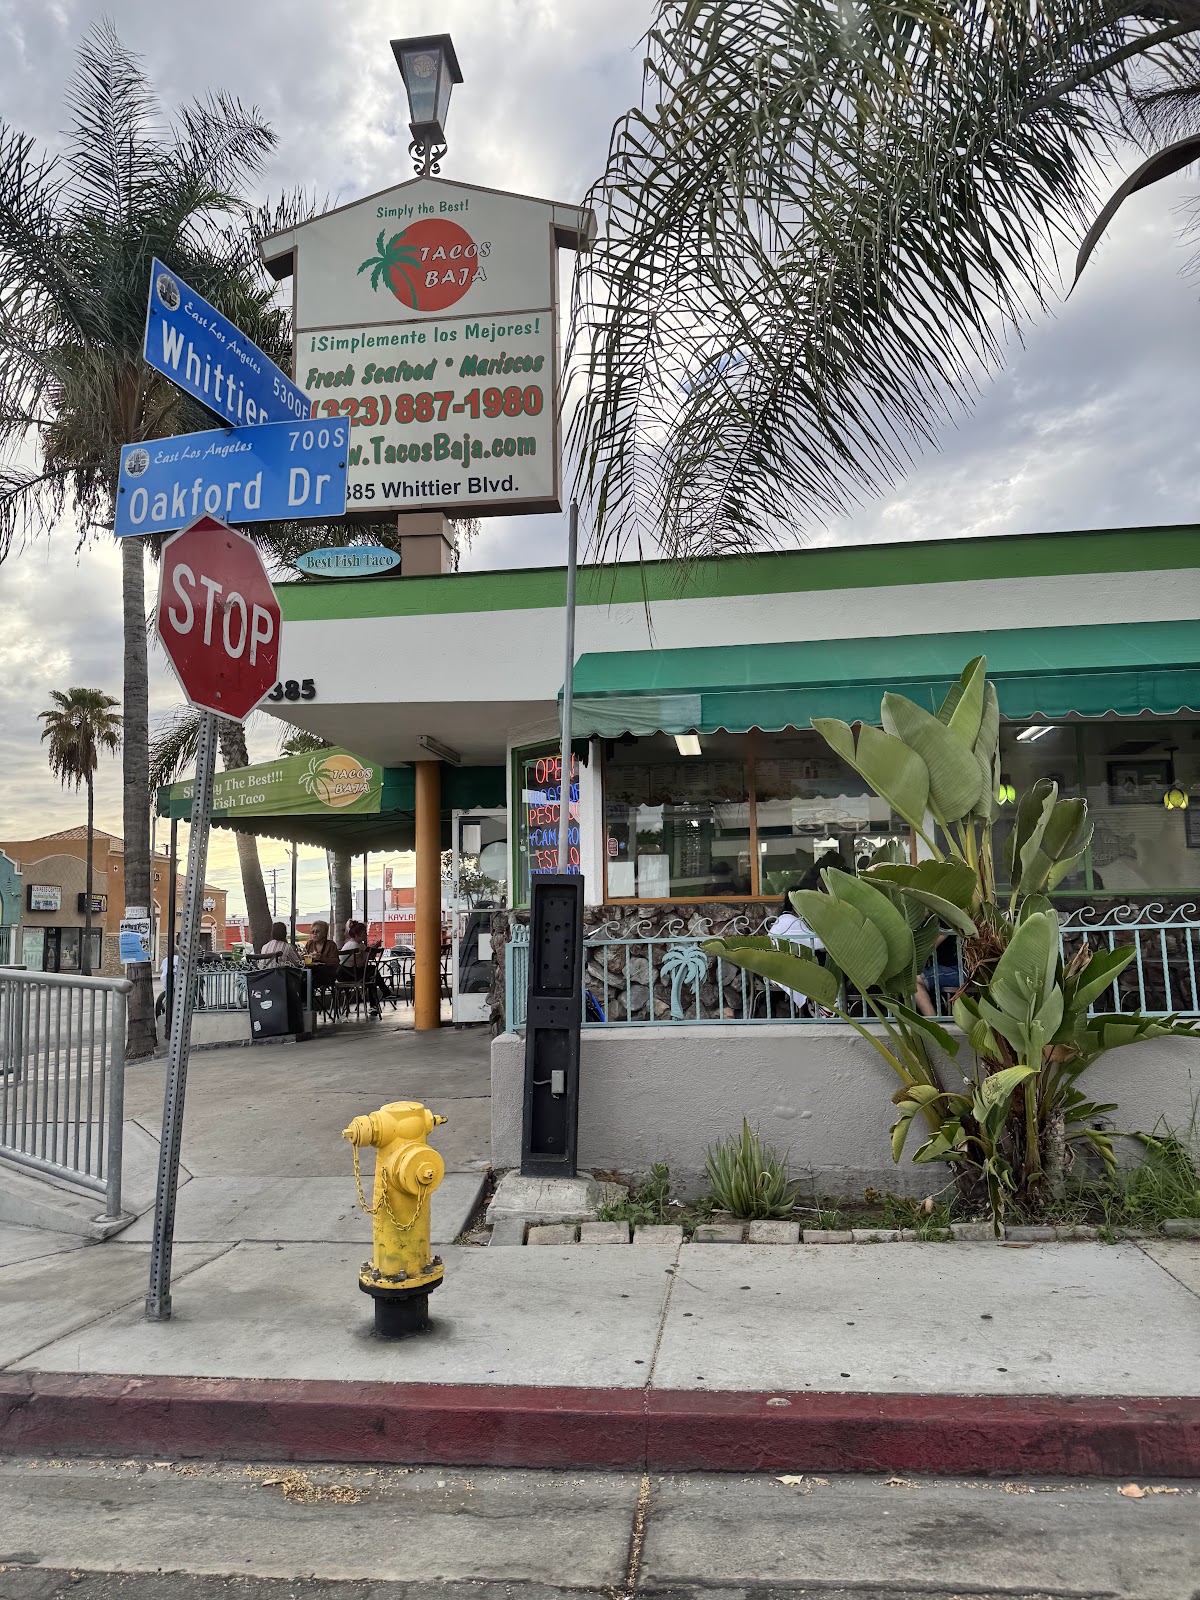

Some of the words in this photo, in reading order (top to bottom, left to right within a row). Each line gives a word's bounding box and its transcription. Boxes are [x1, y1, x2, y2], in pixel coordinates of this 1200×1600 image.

[376, 204, 414, 219] Simply
[417, 202, 436, 215] the
[439, 199, 469, 213] Best!
[420, 241, 492, 262] TACOS
[424, 266, 488, 289] BAJA
[184, 302, 208, 328] East
[208, 321, 226, 344] Los
[226, 340, 261, 375] Angeles
[310, 329, 427, 353] ¡Simplemente
[433, 327, 458, 344] los
[465, 318, 541, 344] Mejores!
[162, 318, 269, 425] Whittier
[305, 363, 356, 391] Fresh
[361, 358, 438, 386] Seafood
[459, 351, 545, 379] Mariscos
[288, 427, 345, 452] 700S
[154, 452, 180, 465] East
[181, 445, 201, 460] Los
[203, 441, 253, 460] Angeles
[129, 471, 263, 525] Oakford
[288, 467, 332, 508] Dr
[381, 477, 462, 500] Whittier
[468, 474, 520, 495] Blvd.
[306, 556, 332, 569] Best
[334, 553, 361, 568] Fish
[363, 553, 395, 566] Taco
[168, 563, 274, 667] STOP
[225, 778, 245, 791] The
[248, 770, 284, 786] Best!!!
[332, 767, 374, 780] TACOS
[334, 782, 371, 794] BAJA
[213, 795, 236, 810] Fish
[238, 793, 265, 806] Taco
